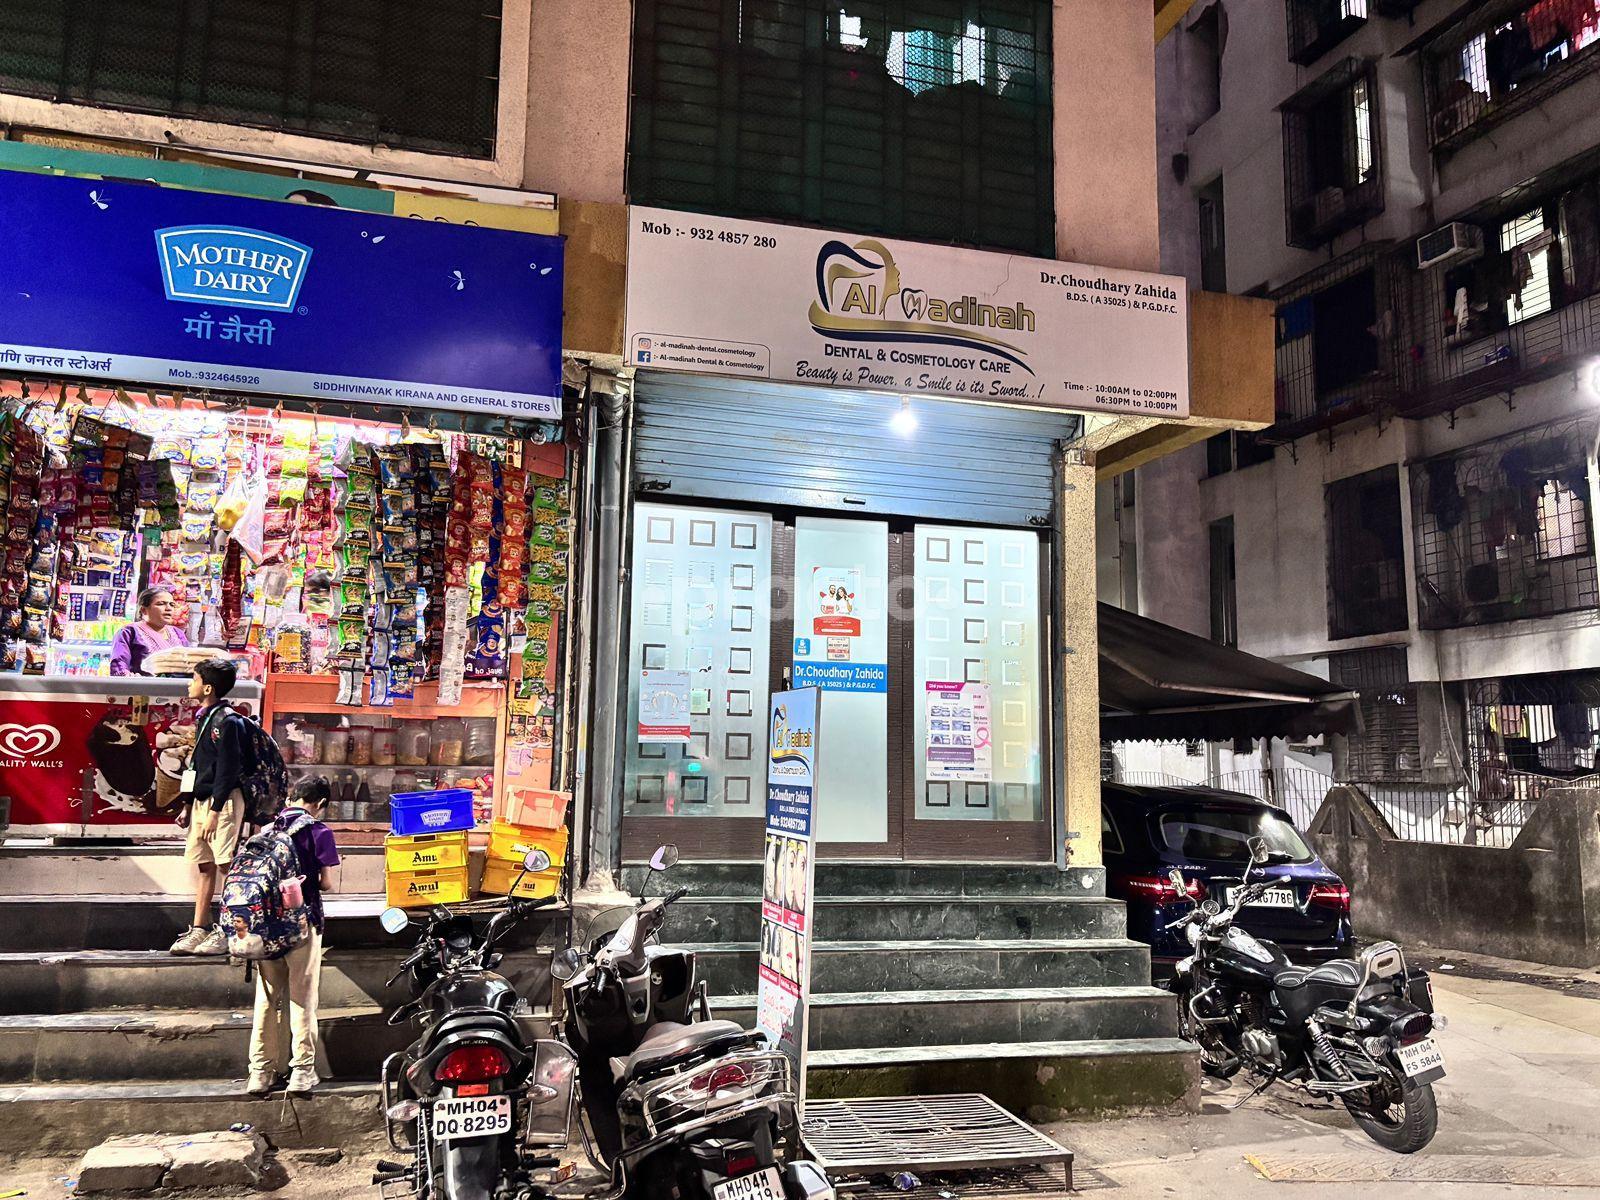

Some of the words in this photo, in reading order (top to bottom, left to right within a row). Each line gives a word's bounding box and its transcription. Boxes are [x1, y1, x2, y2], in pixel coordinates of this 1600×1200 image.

[641, 221, 672, 236] Mob
[690, 227, 714, 241] 932
[717, 230, 750, 245] 4857
[753, 235, 777, 249] 280
[172, 243, 293, 280] MOTHER
[194, 269, 275, 295] DAIRY
[1040, 271, 1131, 296] Dr.Choudhary
[1134, 282, 1177, 300] Zahida
[840, 282, 877, 315] Al
[901, 287, 1036, 332] Madinah
[1103, 295, 1126, 307] 35025
[1132, 299, 1141, 309] &
[183, 311, 215, 340] माँ
[218, 315, 276, 346] जैसी
[24, 354, 64, 368] जनरल
[697, 358, 718, 366] Dental
[725, 360, 765, 371] Cosmetology
[824, 343, 873, 361] DENTAL
[876, 350, 887, 362] &
[890, 350, 976, 370] COSMETOLOGY
[979, 358, 1011, 374] CARE
[796, 360, 839, 385] Beauty
[842, 368, 853, 381] is
[904, 375, 913, 387] a
[916, 373, 952, 391] Smile
[955, 379, 966, 392] is
[969, 379, 985, 394] its
[313, 381, 392, 397] SIDDHIVINAYAK
[395, 388, 434, 401] KIRANA
[436, 392, 458, 403] AND
[460, 394, 509, 408] GENERAL
[511, 399, 551, 412] STORES
[1063, 380, 1084, 392] Time
[1095, 384, 1130, 397] 10:00AM
[1132, 388, 1142, 397] to
[1143, 388, 1177, 400] 02:00PM
[1095, 395, 1130, 407] 06:30PM
[1132, 399, 1142, 408] to
[1143, 399, 1178, 411] 10:00PM
[795, 665, 854, 681] Dr.Choudhary
[855, 667, 884, 680] Zahida
[31, 760, 64, 768] WALL'S
[407, 881, 439, 893] Amul
[1404, 1046, 1419, 1059] MH
[1406, 1061, 1419, 1072] FS
[1420, 1053, 1442, 1068] 5844
